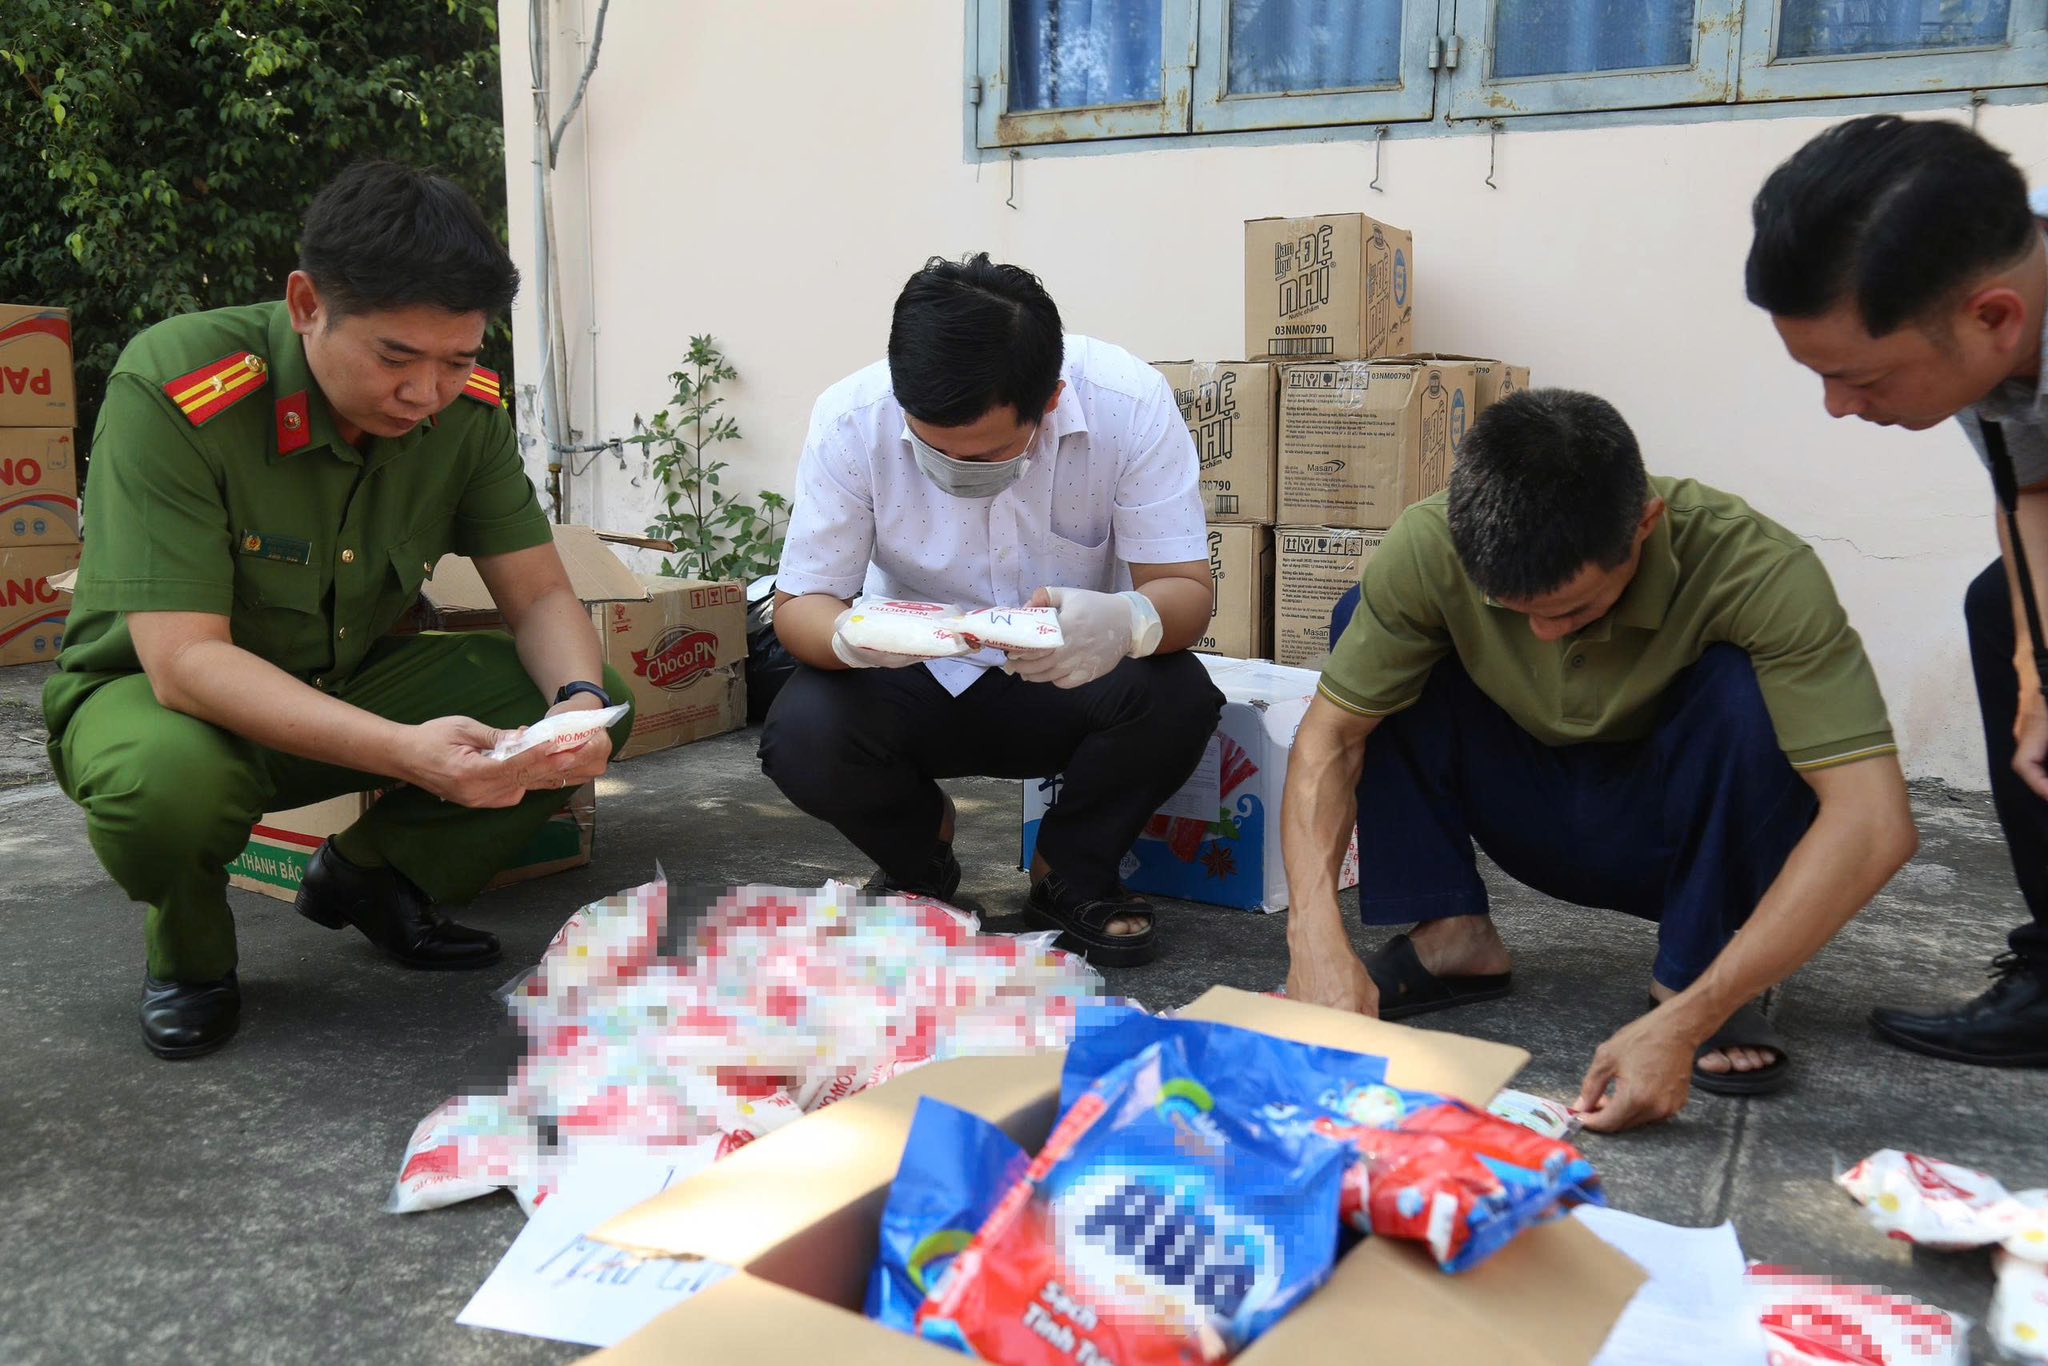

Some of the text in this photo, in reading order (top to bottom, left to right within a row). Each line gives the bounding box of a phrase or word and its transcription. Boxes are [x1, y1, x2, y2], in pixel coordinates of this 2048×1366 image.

[1275, 324, 1327, 335] 03NM00790
[1371, 372, 1411, 380] 03NM00790
[1307, 463, 1333, 472] Masan
[1303, 628, 1329, 637] Masan
[240, 851, 304, 882] THÀNH BẮC
